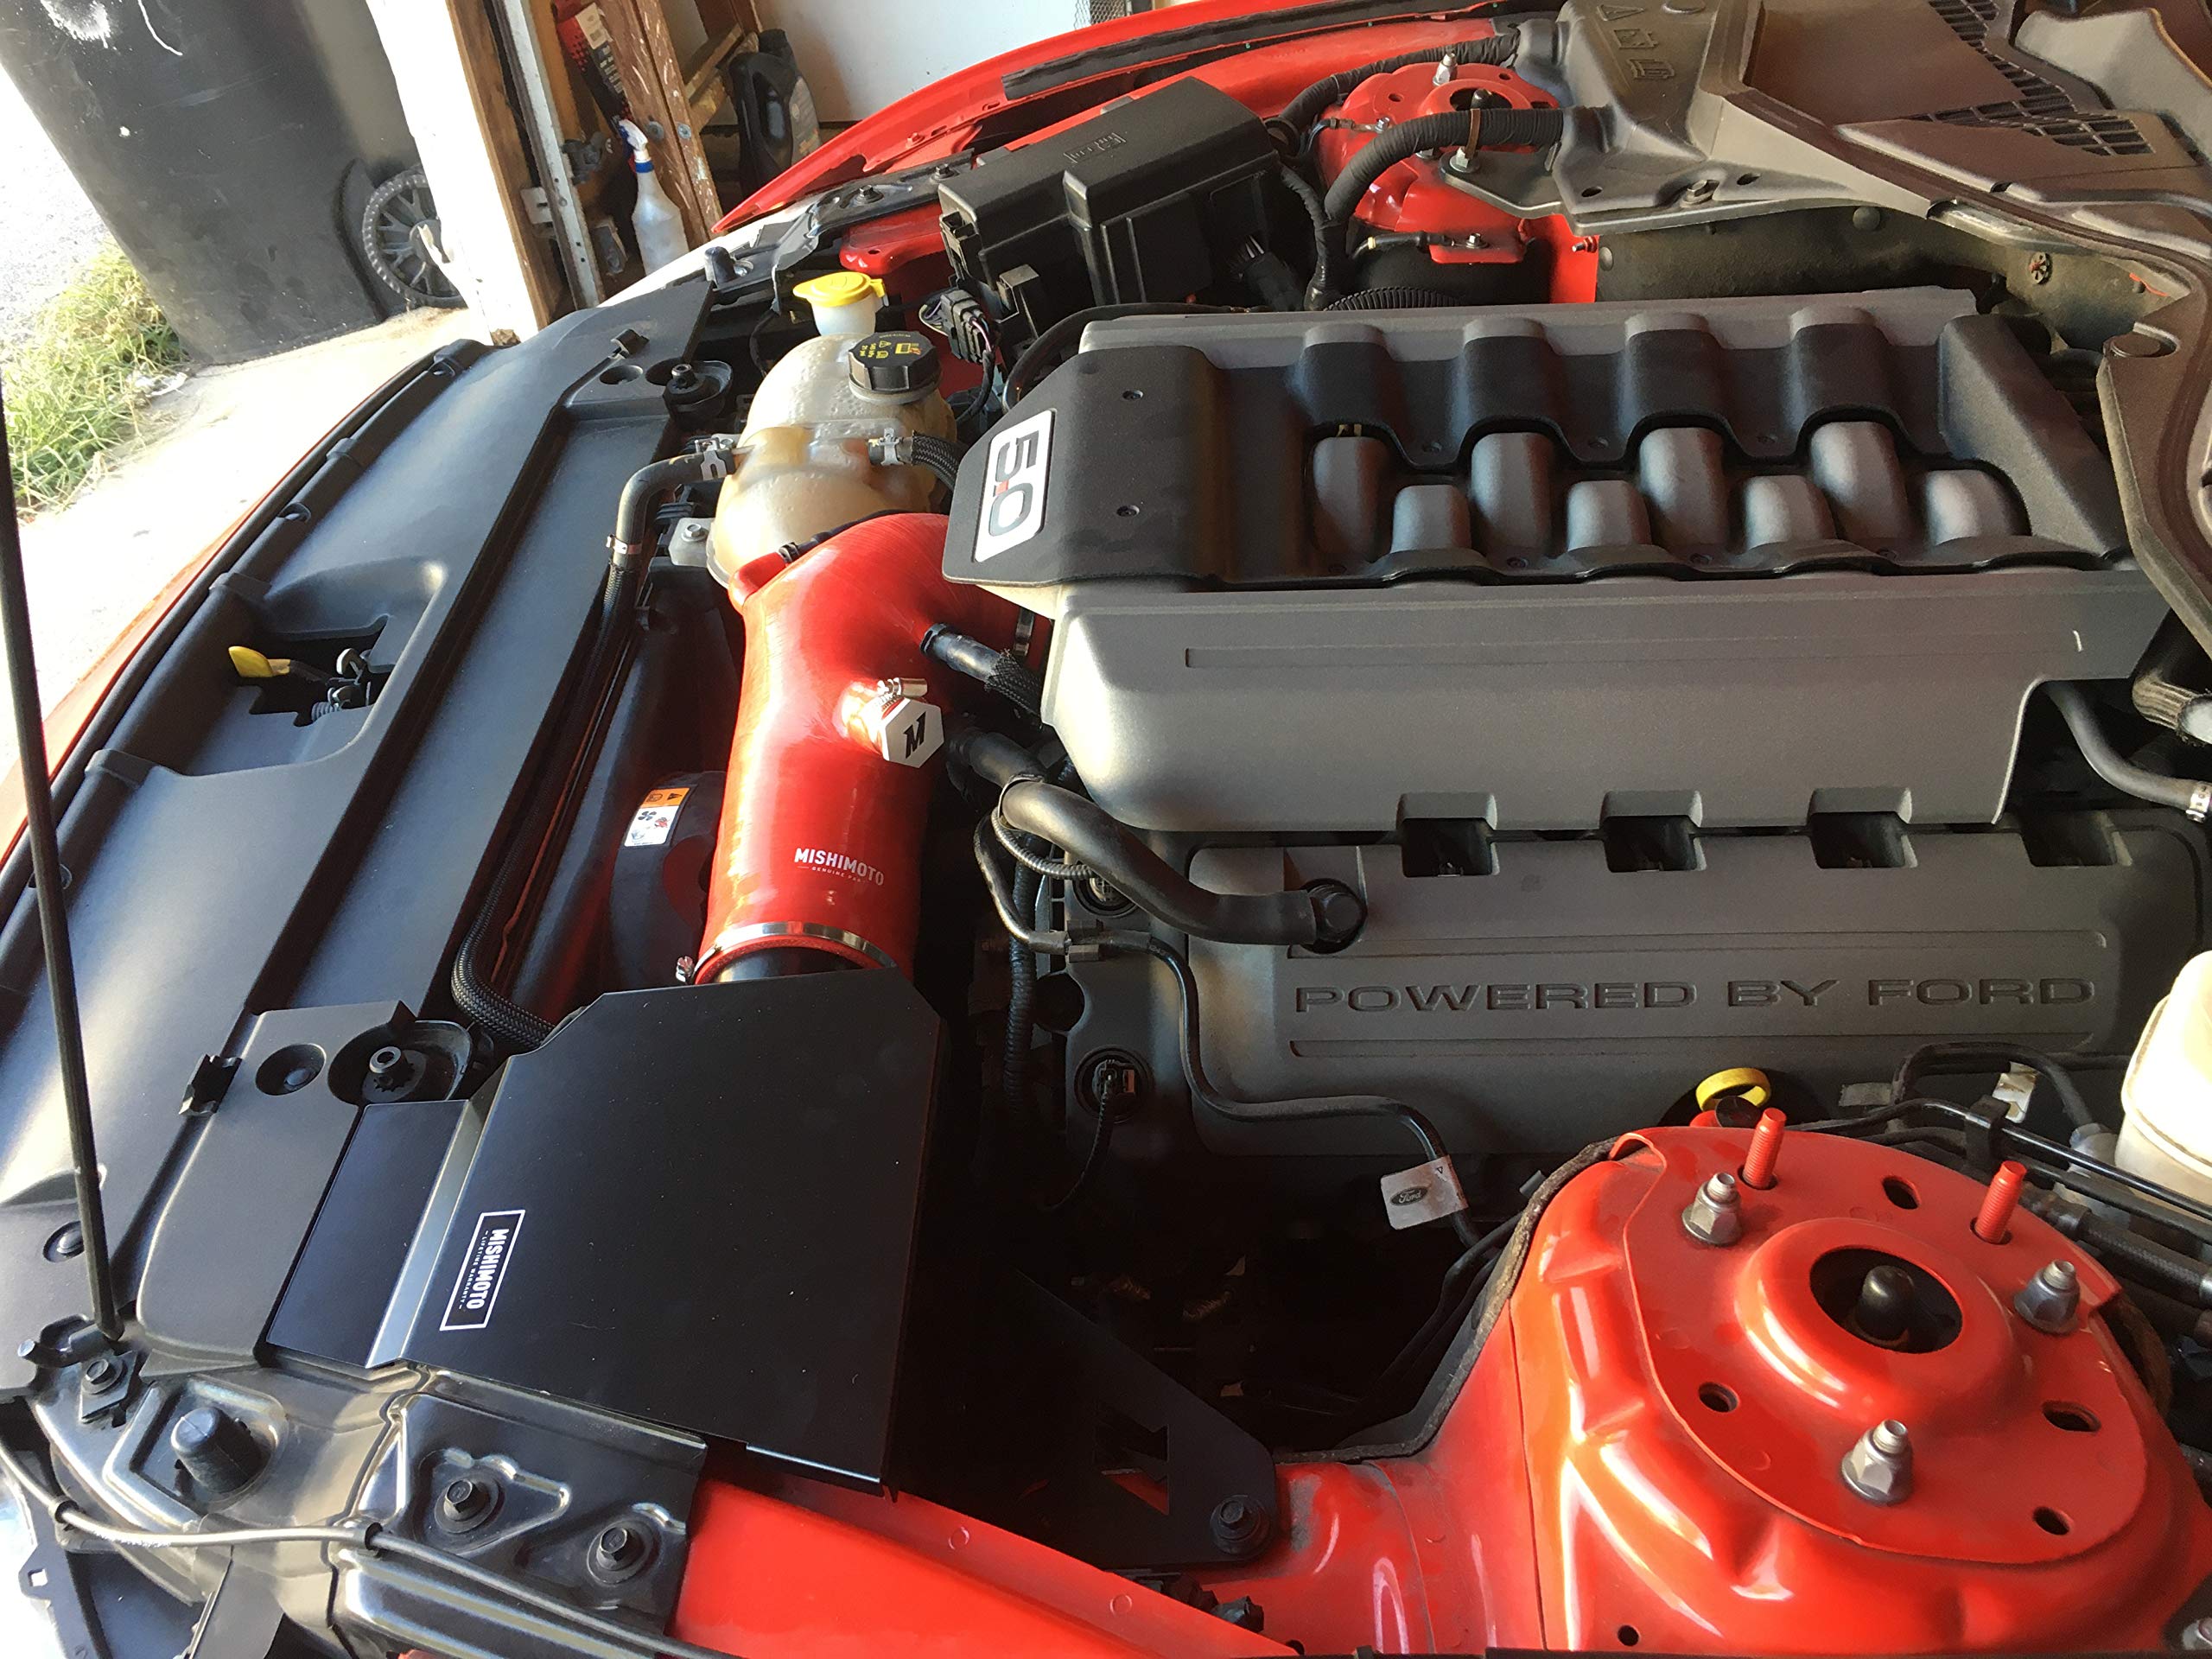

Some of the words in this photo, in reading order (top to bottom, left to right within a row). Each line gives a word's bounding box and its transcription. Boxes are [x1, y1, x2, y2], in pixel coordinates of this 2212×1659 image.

[988, 430, 1039, 537] 5.0
[903, 711, 926, 759] M
[794, 848, 884, 886] MISHIMOTO
[812, 866, 845, 878] GENUINE
[1296, 982, 1698, 1013] POWERED
[1728, 979, 1840, 1007] BY
[1868, 978, 2095, 1005] FORD
[467, 1229, 509, 1309] MISHIMOTO
[473, 1236, 488, 1266] LIFETIME
[461, 1268, 476, 1304] WARRANTY
